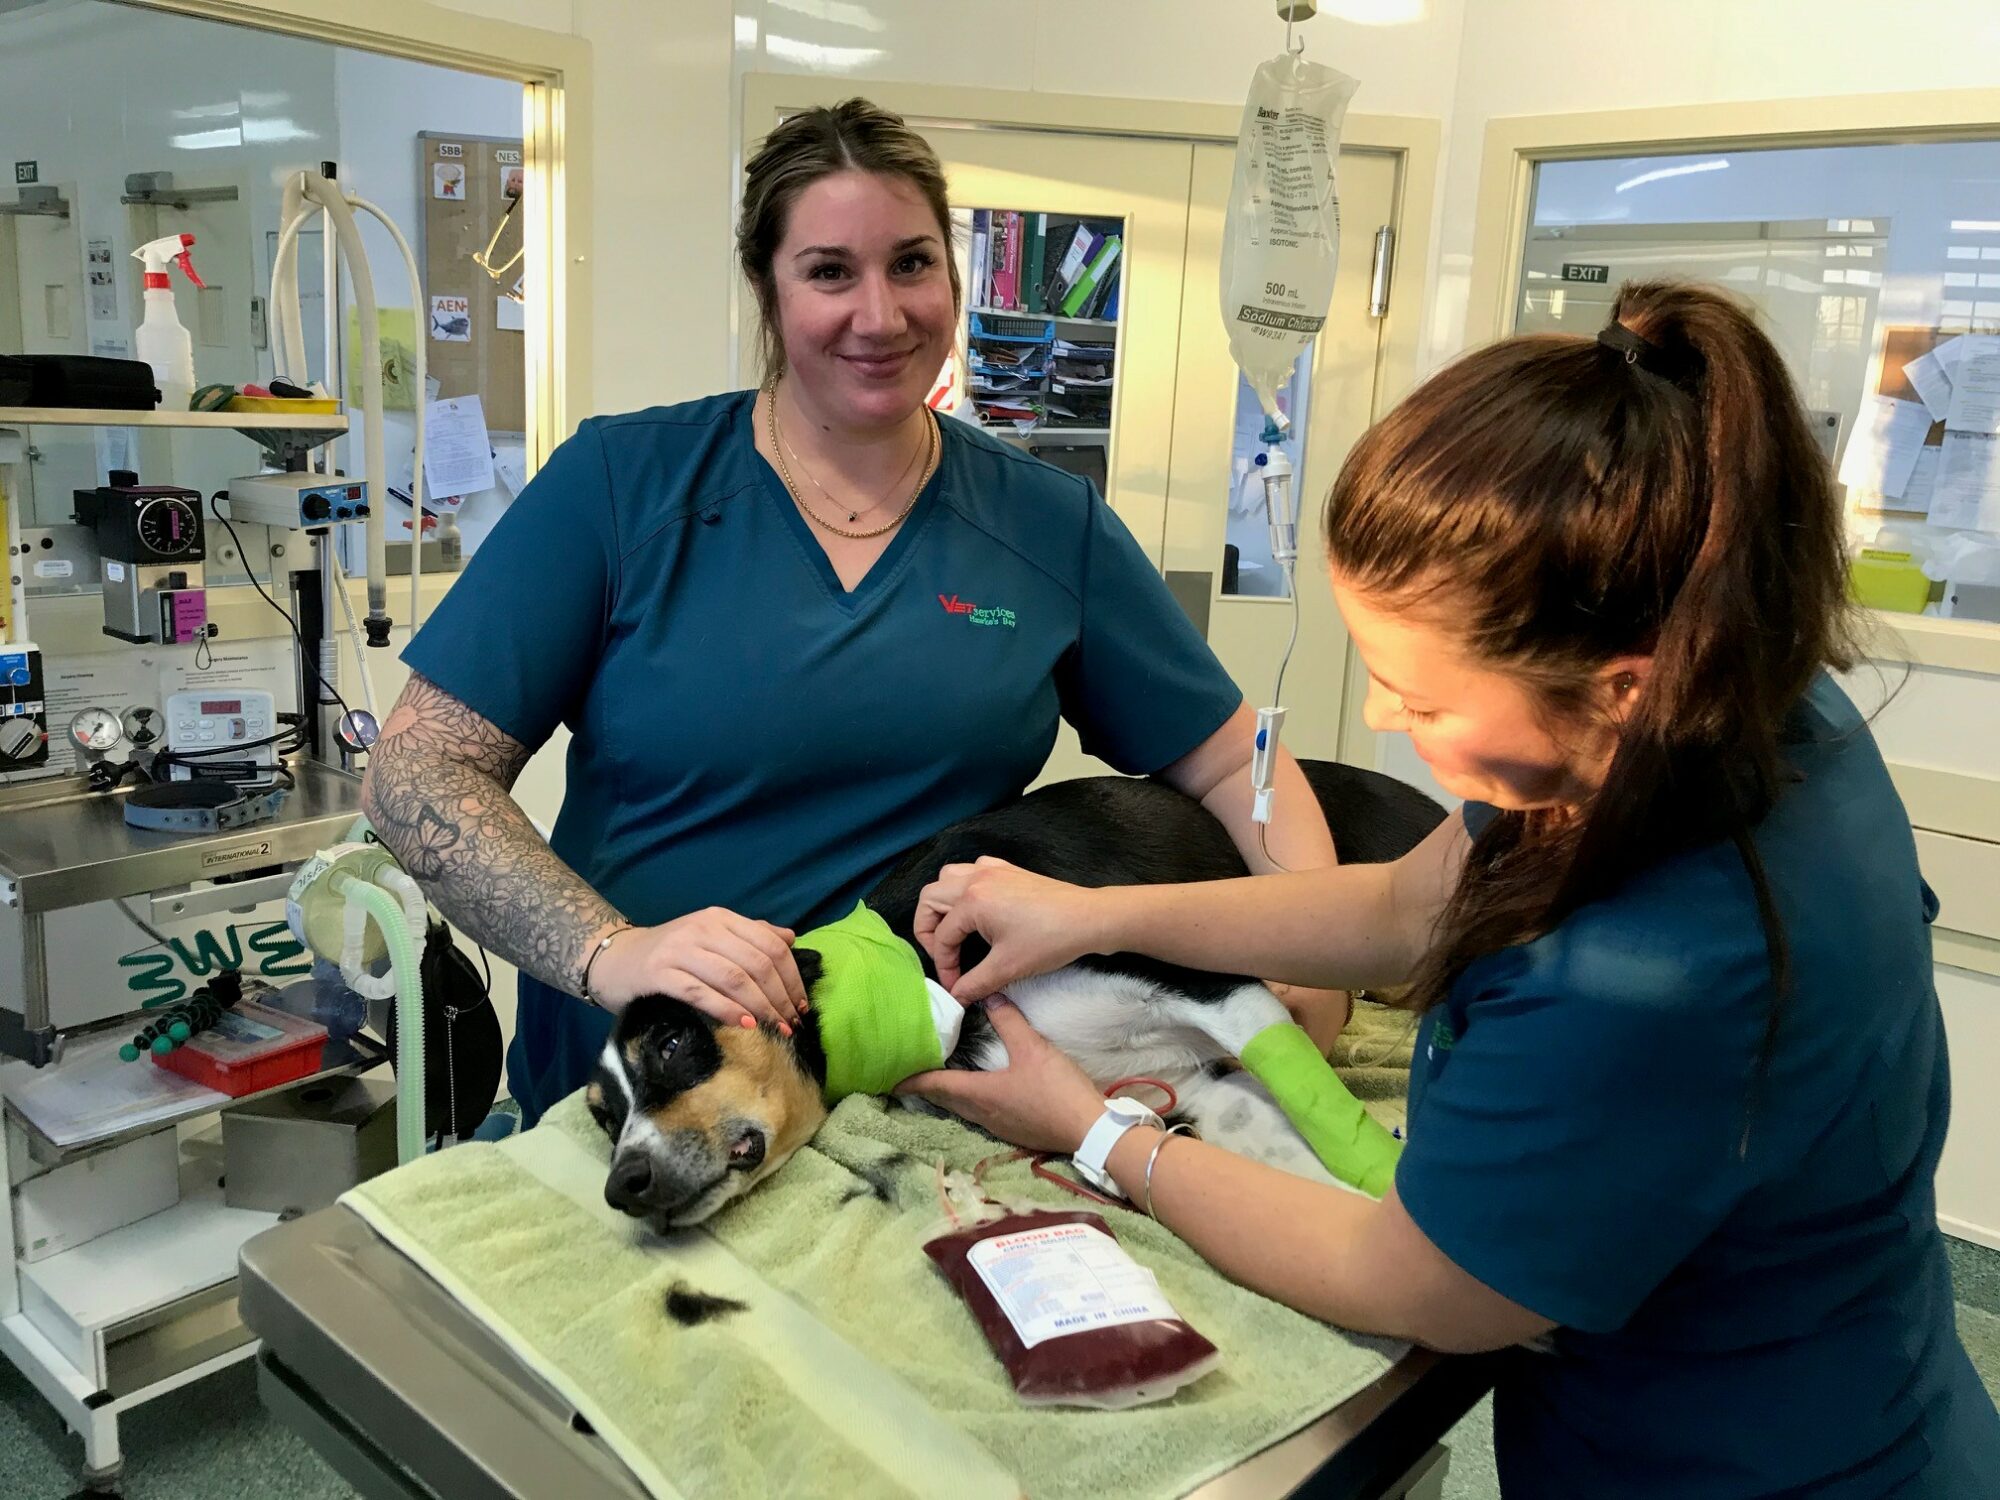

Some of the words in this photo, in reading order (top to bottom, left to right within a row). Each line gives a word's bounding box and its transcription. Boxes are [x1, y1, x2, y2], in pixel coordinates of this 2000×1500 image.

[1257, 106, 1279, 120] Baxter
[441, 145, 461, 156] SBB
[498, 152, 519, 162] NES
[18, 165, 34, 180] EXIT
[1568, 266, 1602, 280] EXIT
[1265, 282, 1286, 297] 500
[1287, 289, 1299, 299] mL
[436, 300, 465, 312] AEN
[1241, 308, 1286, 327] Sodium
[973, 606, 1016, 619] services
[206, 848, 259, 863] INTERNATIONAL
[260, 843, 269, 855] 2
[996, 1232, 1049, 1247] BLOOD
[1053, 1227, 1085, 1237] BAG
[1054, 1315, 1089, 1328] MADE
[1094, 1311, 1107, 1321] IN
[1113, 1305, 1150, 1318] CHINA
